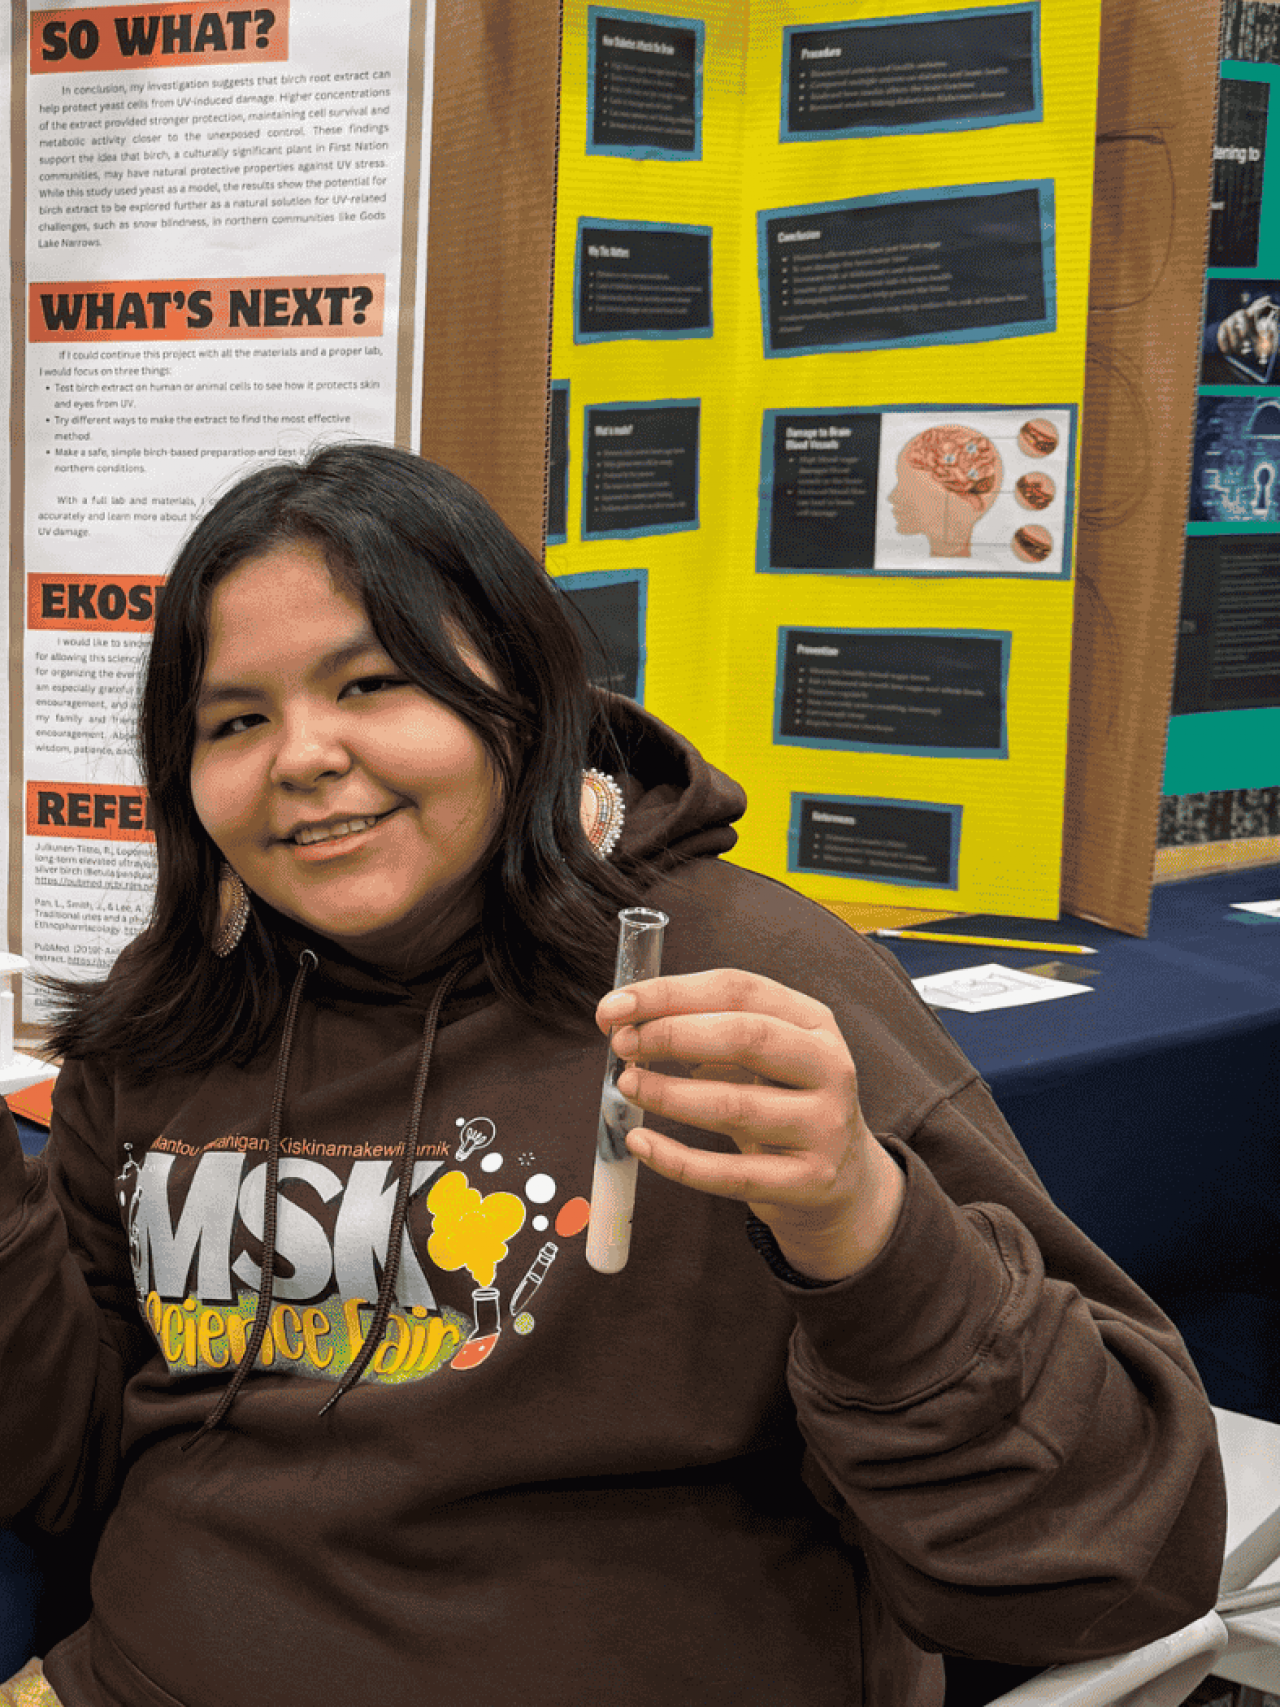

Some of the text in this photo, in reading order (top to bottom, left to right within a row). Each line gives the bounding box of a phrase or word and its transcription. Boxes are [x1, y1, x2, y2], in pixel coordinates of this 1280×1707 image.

[42, 9, 276, 62] SO WHAT?
[61, 70, 391, 96] In conclusion, my investigation suggests that birch root extract can
[1248, 146, 1260, 161] to
[228, 286, 374, 328] NEXT?
[53, 397, 136, 411] and eyes from UV.
[53, 412, 351, 426] Try different ways to make the extract to find the most effective
[136, 1151, 446, 1312] MSK
